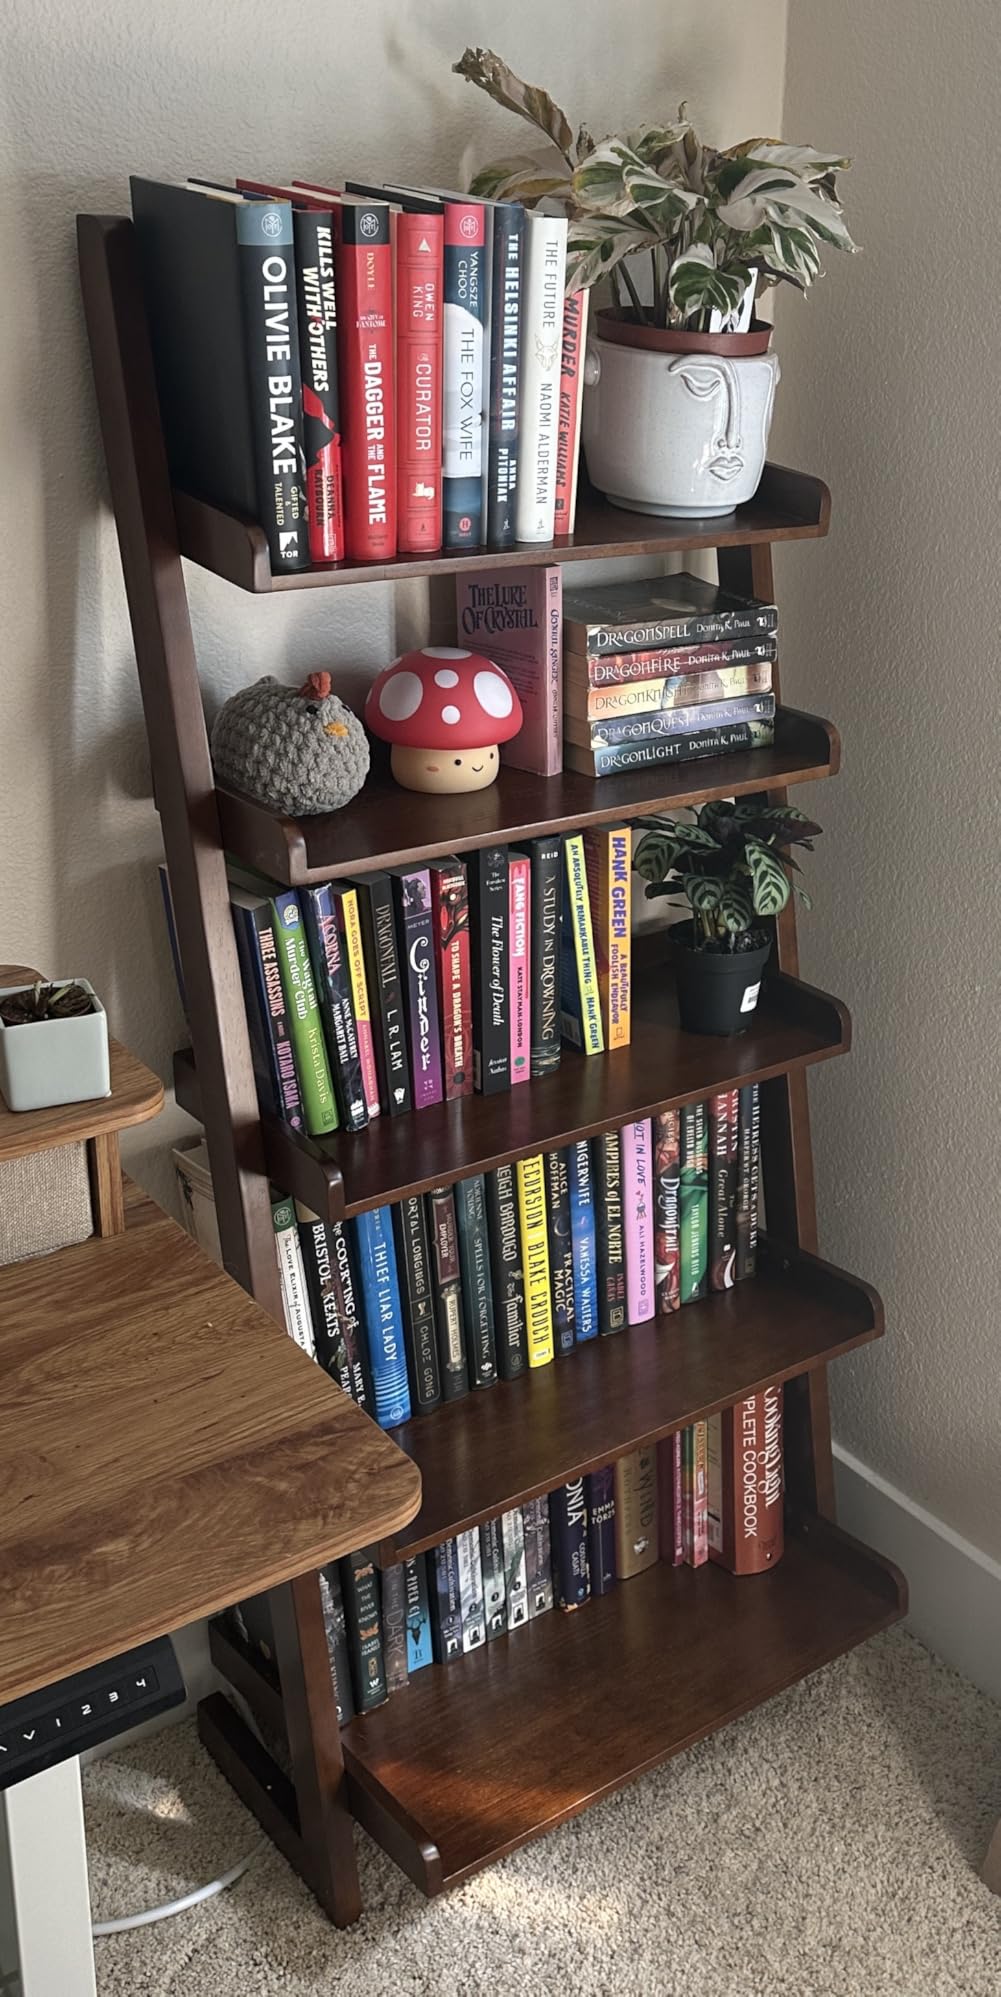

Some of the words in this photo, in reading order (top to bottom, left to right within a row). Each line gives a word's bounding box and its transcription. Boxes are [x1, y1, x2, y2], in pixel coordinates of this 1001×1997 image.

[317, 226, 334, 278] KILLS
[508, 234, 519, 260] THE
[545, 241, 558, 267] THE
[367, 252, 375, 288] DOYLE
[458, 260, 468, 299] CHOO
[470, 251, 479, 307] YANGSZE
[262, 256, 291, 361] OLIVIE
[303, 267, 322, 318] WITH
[322, 281, 337, 330] WELL
[412, 286, 424, 317] KING
[424, 283, 435, 320] OWEN
[543, 273, 557, 328] FUTURE
[503, 267, 519, 357] HELSINKI
[308, 320, 330, 392] OTHERS
[369, 344, 377, 360] THE
[460, 328, 475, 363] THE
[561, 298, 580, 378] MURDER
[364, 361, 385, 441] DAGGER
[415, 364, 432, 450] CURATOR
[460, 371, 474, 409] FOX
[501, 364, 518, 430] AFFAIR
[539, 383, 552, 427] NAOMI
[268, 375, 297, 475] BLAKE
[560, 392, 570, 428] KATIE
[368, 445, 376, 460] THE
[376, 444, 384, 460] AND
[459, 416, 473, 461] WIFE
[497, 448, 509, 503] PITONIAK
[508, 460, 517, 490] ANNA
[536, 433, 550, 504] ALDERMAN
[556, 432, 569, 488] WILLIAMS
[274, 482, 285, 526] TALENTED
[290, 486, 299, 519] GIFTED
[326, 475, 336, 520] DEANNA
[368, 464, 387, 525] FLAME
[468, 584, 495, 608] THE
[494, 583, 527, 607] LURE
[462, 607, 484, 635] OF
[484, 606, 539, 635] CRYSTAL
[597, 624, 691, 647] DRAGONSPELL
[594, 656, 680, 681] DRAGONFIRE
[600, 743, 683, 768] DRAGONLIGHT
[570, 844, 579, 856] AN
[611, 837, 628, 882] HANK
[545, 875, 556, 884] A
[572, 857, 584, 902] ABSOLUTELY
[347, 899, 356, 926] NORA
[491, 915, 504, 938] The
[543, 887, 556, 935] STUDY
[611, 886, 627, 938] GREEN
[258, 927, 277, 961] THREE
[318, 915, 342, 976] ACORNA
[350, 930, 360, 957] GOES
[375, 903, 397, 989] DRAGONFALL
[451, 940, 459, 952] TO
[544, 939, 554, 952] IN
[576, 904, 589, 956] REMARKABLE
[354, 959, 362, 978] OFF
[451, 953, 461, 981] SHAPE
[491, 938, 504, 975] Flower
[582, 956, 592, 985] THING
[610, 943, 619, 979] FOOLISH
[263, 962, 286, 1017] ASSASSINS
[285, 937, 300, 987] Murder
[295, 990, 308, 1020] Club
[302, 958, 318, 1010] Wagtail
[452, 983, 461, 991] A
[489, 977, 504, 992] of
[357, 981, 367, 1017] SCRIPT
[387, 1009, 398, 1022] L.
[410, 936, 431, 1071] Cinder
[452, 991, 463, 1034] DRAGON'S
[492, 991, 505, 1026] Death
[540, 955, 557, 1041] DROWNING
[586, 996, 597, 1021] HANK
[610, 980, 620, 1025] ENDEAVOR
[332, 1003, 346, 1043] MARGARET
[388, 1024, 399, 1040] R.
[588, 1019, 600, 1049] GREEN
[276, 1040, 295, 1079] KOTARO
[308, 1027, 321, 1068] Krista
[315, 1068, 329, 1104] Davis
[338, 1044, 349, 1064] BALL
[390, 1041, 403, 1071] LAM
[453, 1034, 464, 1068] BREATH
[282, 1079, 300, 1110] ISAKA
[635, 1144, 646, 1155] IN
[496, 1164, 512, 1200] LEIGH
[549, 1152, 560, 1209] HOFFMAN
[559, 1162, 568, 1195] ALICE
[576, 1139, 590, 1207] NIGERWIFE
[635, 1159, 647, 1187] LOVE
[718, 1169, 728, 1199] Great
[604, 1190, 621, 1202] of
[607, 1204, 621, 1222] EL
[658, 1176, 680, 1252] Dragonfruit
[500, 1201, 517, 1262] BARDUGO
[717, 1206, 728, 1238] Alone
[439, 1223, 449, 1259] EMPLOYER
[474, 1238, 484, 1271] SPELLS
[607, 1224, 622, 1265] NORTE
[374, 1241, 390, 1284] THIEF
[412, 1237, 425, 1295] LONGINGS
[527, 1241, 547, 1288] BLAKE
[579, 1236, 591, 1285] VANESSA
[312, 1222, 332, 1285] BRISTOL
[323, 1291, 340, 1338] KEATS
[476, 1272, 486, 1295] FOR
[553, 1269, 566, 1313] MAGIC
[563, 1252, 575, 1323] PRACTICAL
[378, 1288, 393, 1322] LIAR
[530, 1290, 549, 1345] CROUCH
[581, 1287, 593, 1333] WALTERS
[382, 1325, 398, 1362] LADY
[419, 1325, 432, 1363] CHLOE
[478, 1295, 490, 1360] FORGETTING
[352, 1362, 364, 1393] MARY
[423, 1367, 435, 1398] GONG
[357, 1394, 366, 1408] E.
[592, 1500, 615, 1516] EMMA
[743, 1450, 758, 1539] COOKBOOK
[406, 1575, 420, 1604] PIPER
[56, 1718, 61, 1727] 1
[81, 1704, 92, 1715] 2
[109, 1691, 119, 1702] 3
[136, 1678, 146, 1687] 4
